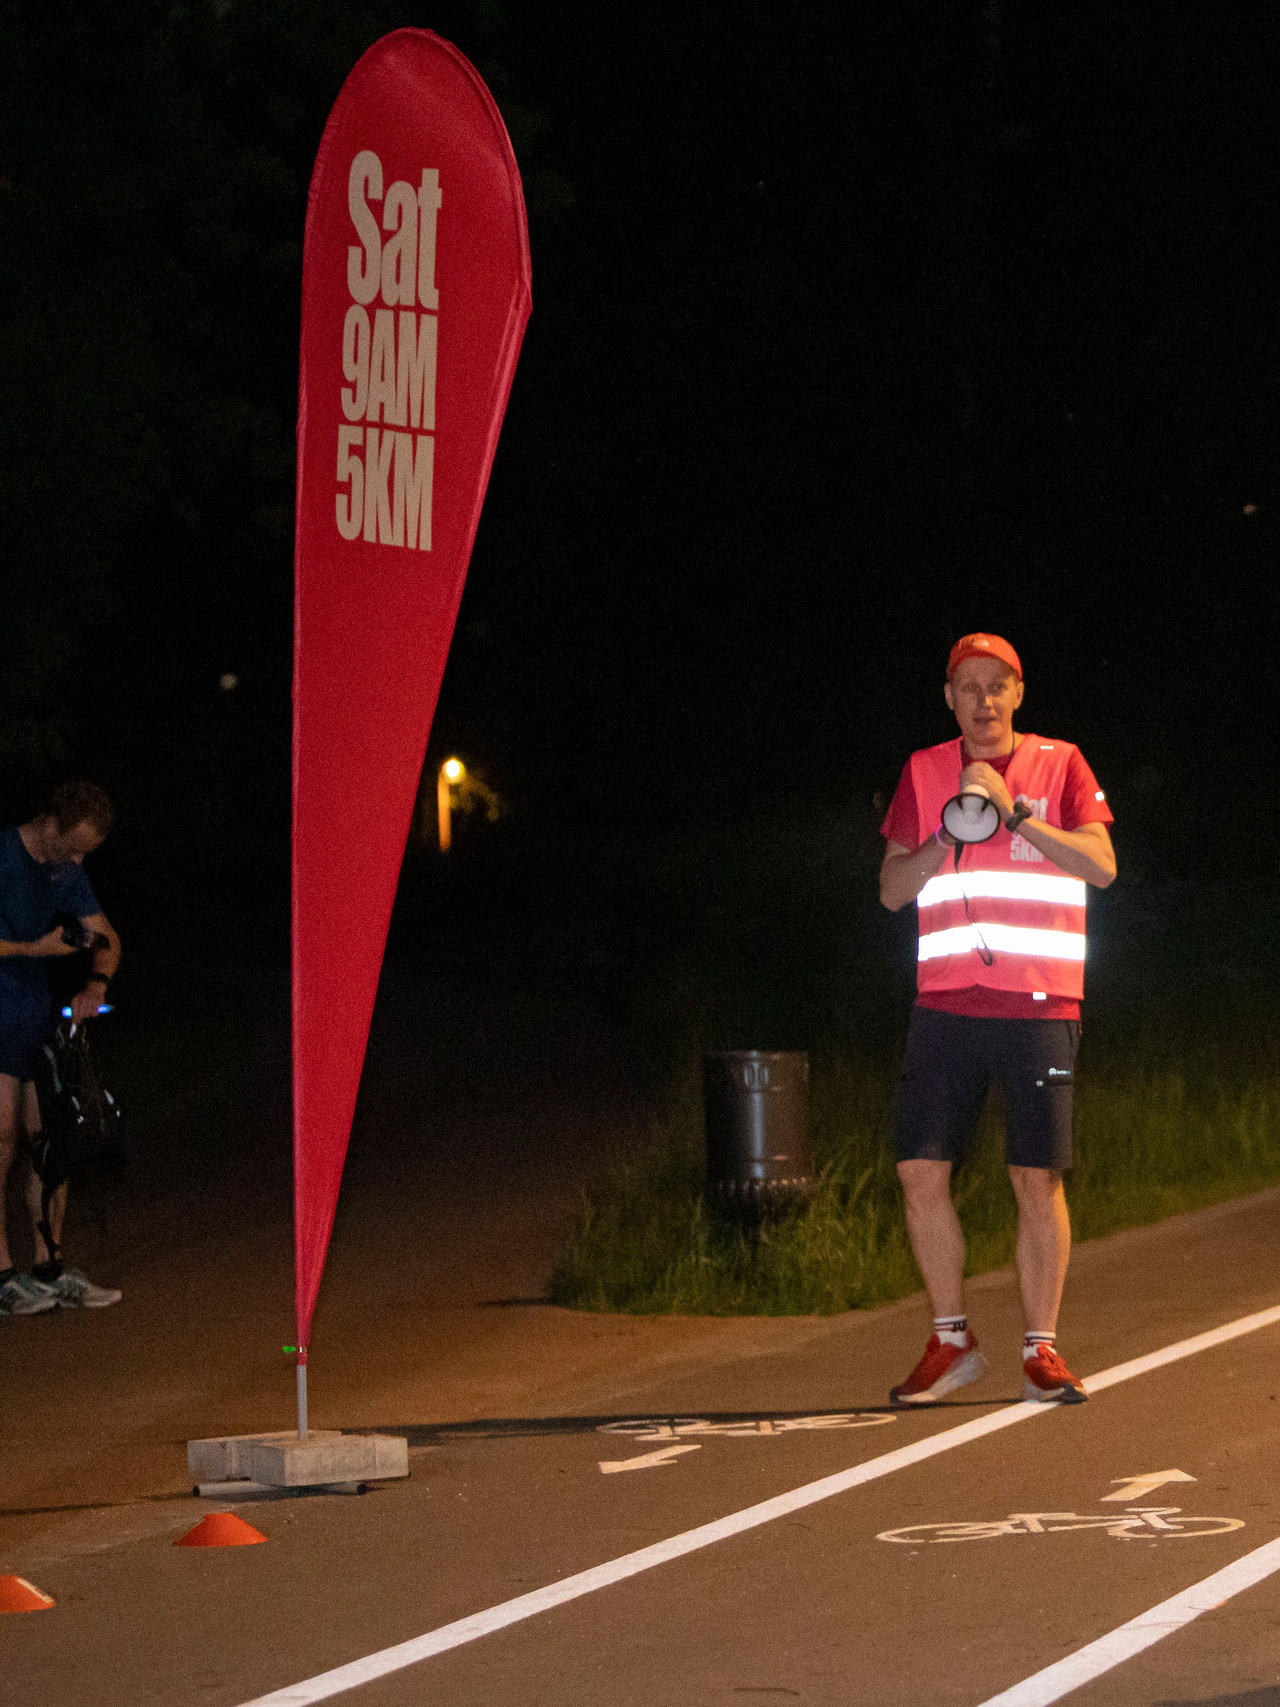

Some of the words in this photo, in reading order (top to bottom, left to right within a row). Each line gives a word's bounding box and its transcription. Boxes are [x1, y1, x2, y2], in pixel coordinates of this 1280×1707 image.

[347, 150, 442, 310] Sat
[341, 304, 438, 430] 9AM
[336, 424, 434, 551] 5KM
